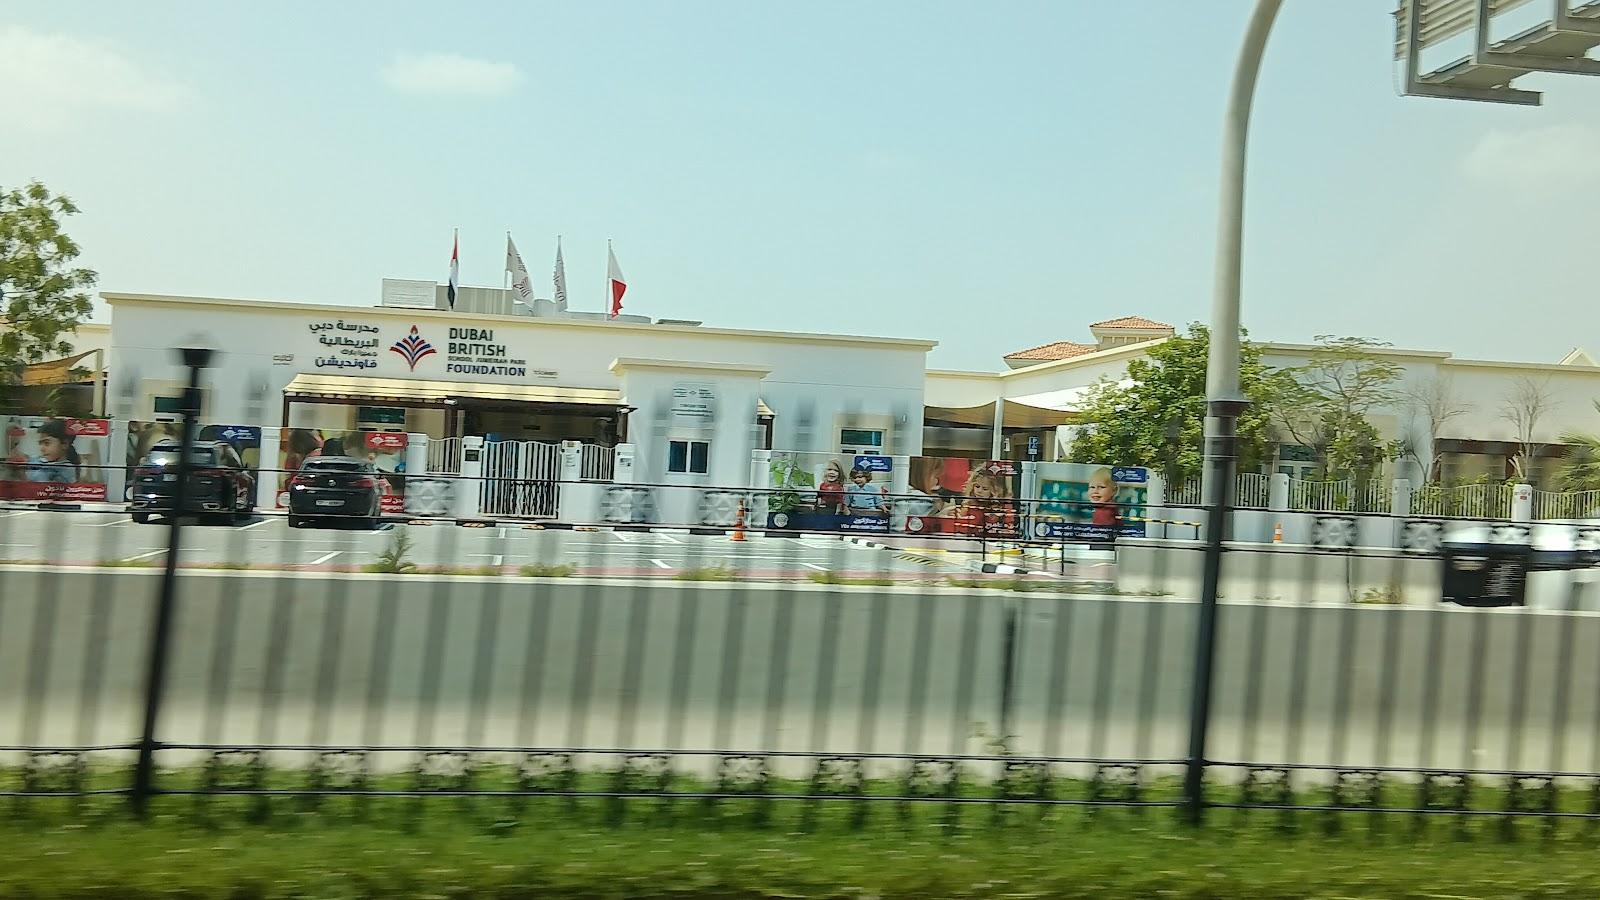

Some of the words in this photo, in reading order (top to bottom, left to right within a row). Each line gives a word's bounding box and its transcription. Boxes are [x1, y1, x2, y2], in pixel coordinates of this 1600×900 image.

[309, 322, 334, 334] دبي
[336, 320, 379, 333] مدرسة
[449, 328, 494, 341] DUBAI
[319, 334, 379, 349] البريطانية
[448, 342, 506, 357] BRITISH
[447, 363, 526, 377] FOUNDATION
